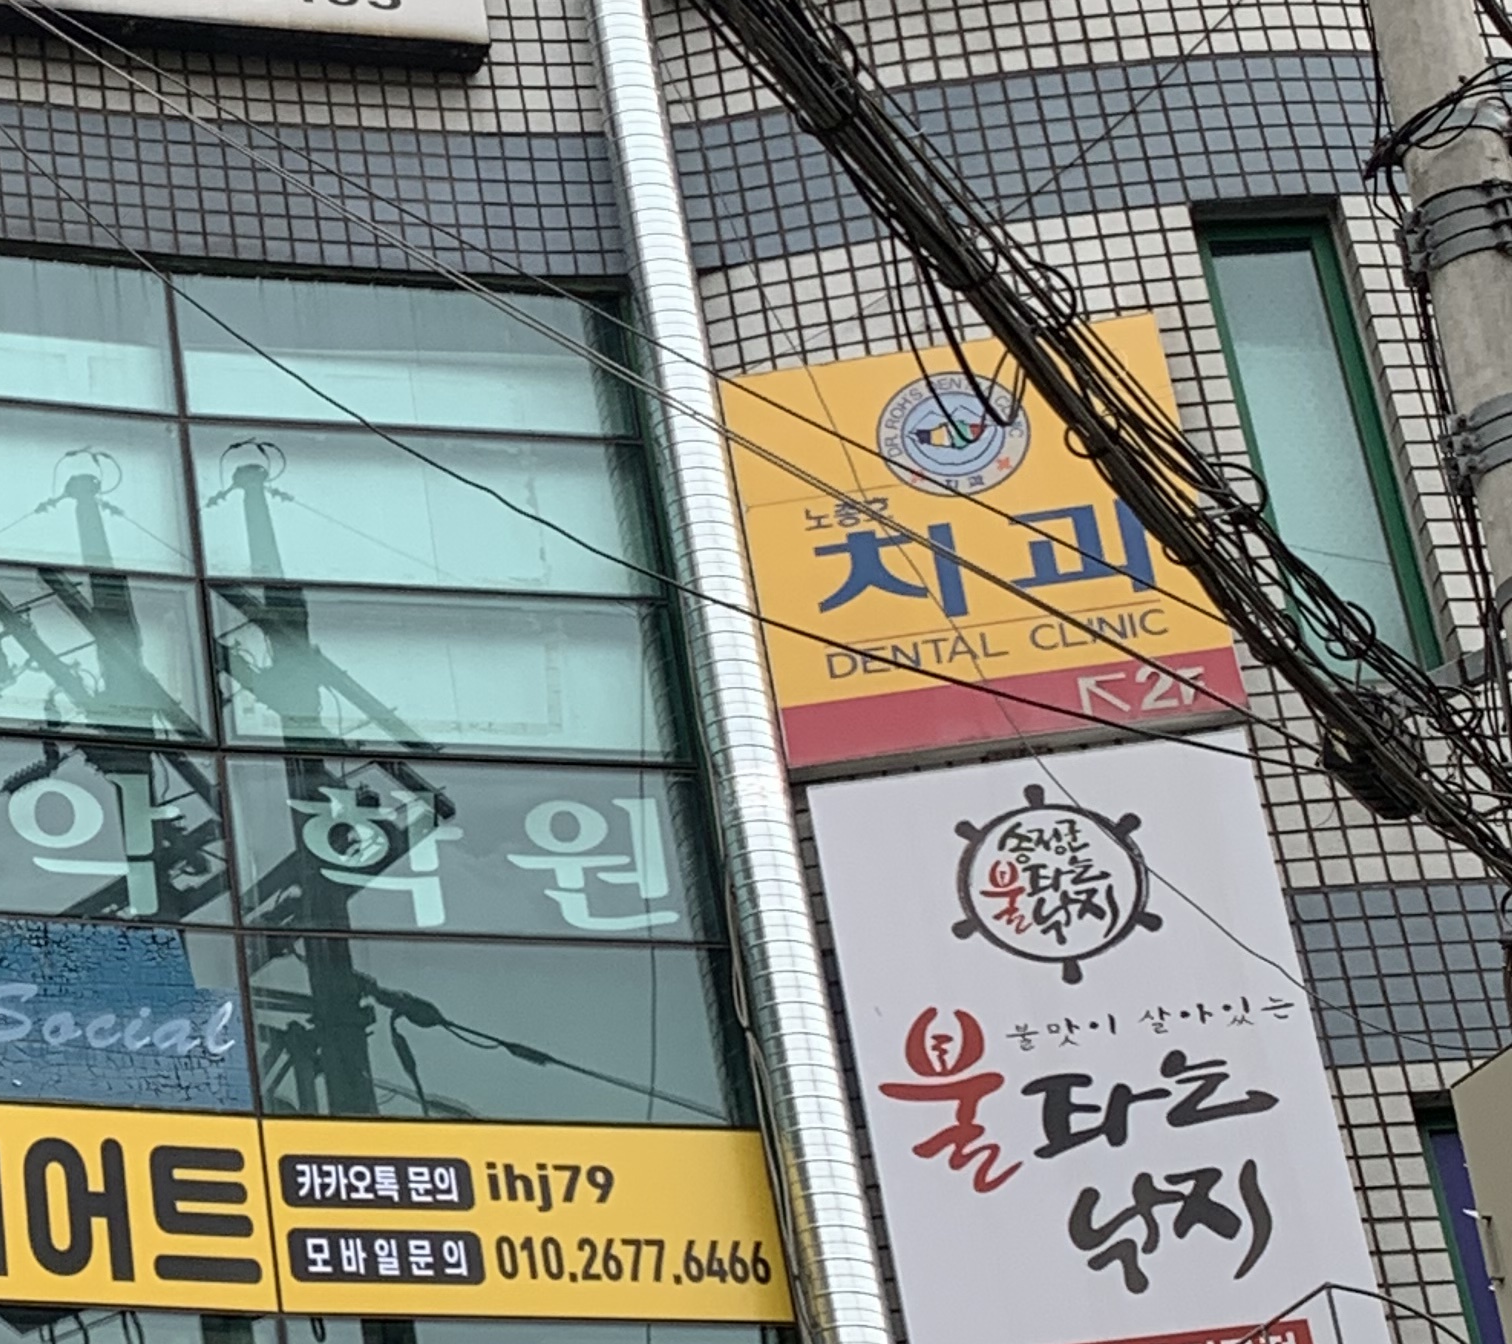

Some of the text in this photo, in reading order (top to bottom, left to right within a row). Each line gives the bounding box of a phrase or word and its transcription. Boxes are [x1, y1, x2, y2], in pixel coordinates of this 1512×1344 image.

[813, 499, 1158, 618] 치과
[826, 607, 1170, 680] DENTAL CLINIC
[1138, 995, 1296, 1035] 살아있는
[295, 1161, 616, 1213] 카카오톡 문의 ihj79
[1068, 1158, 1275, 1295] 낙지
[495, 1235, 774, 1286] 010.2677.6466
